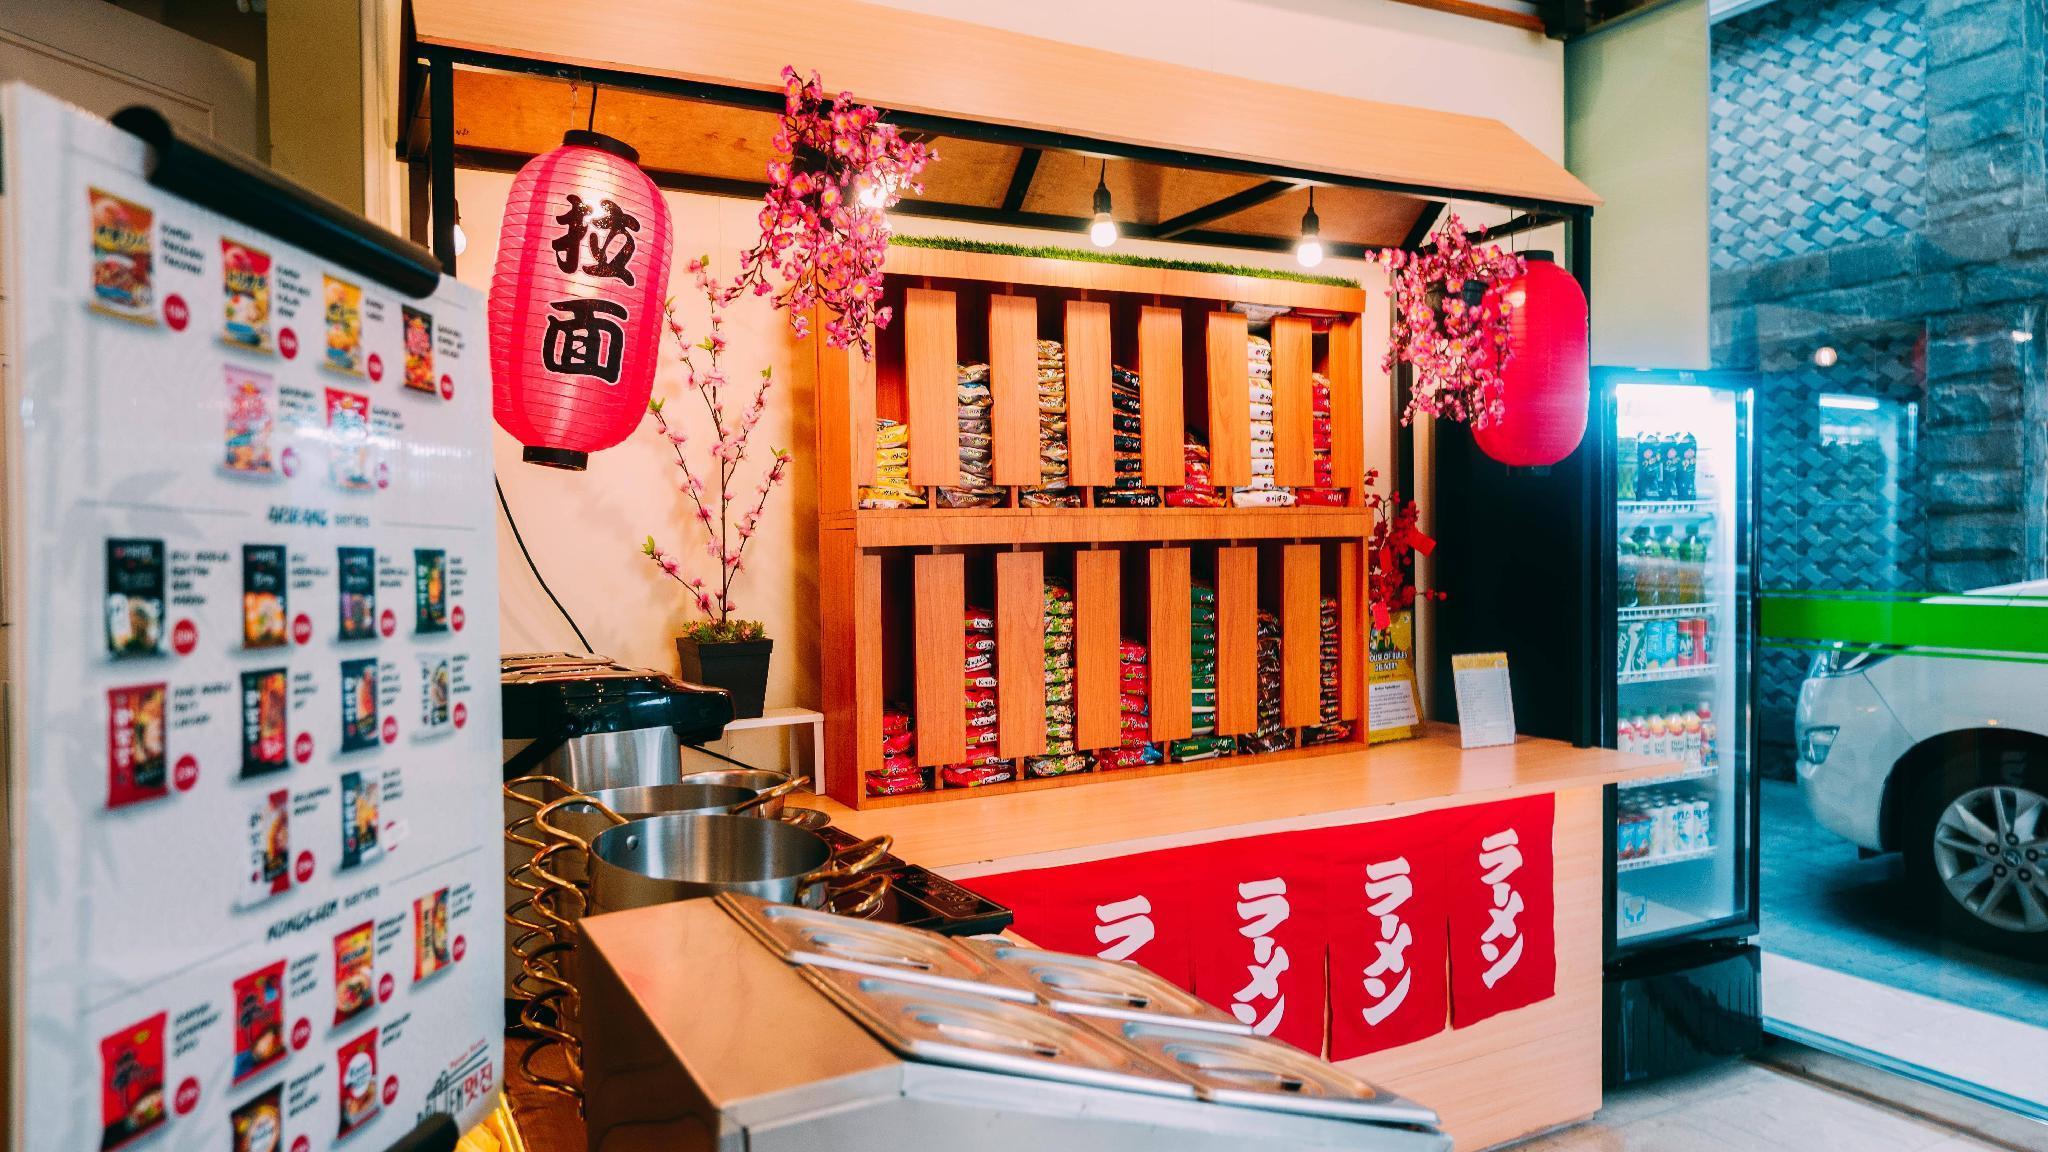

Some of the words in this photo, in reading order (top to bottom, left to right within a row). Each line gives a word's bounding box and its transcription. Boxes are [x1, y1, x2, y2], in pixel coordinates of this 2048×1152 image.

[541, 194, 641, 384] 拉面
[1230, 876, 1291, 1037] ラーメン
[1362, 855, 1413, 1027] ラーメン
[1479, 827, 1525, 989] ラーメン
